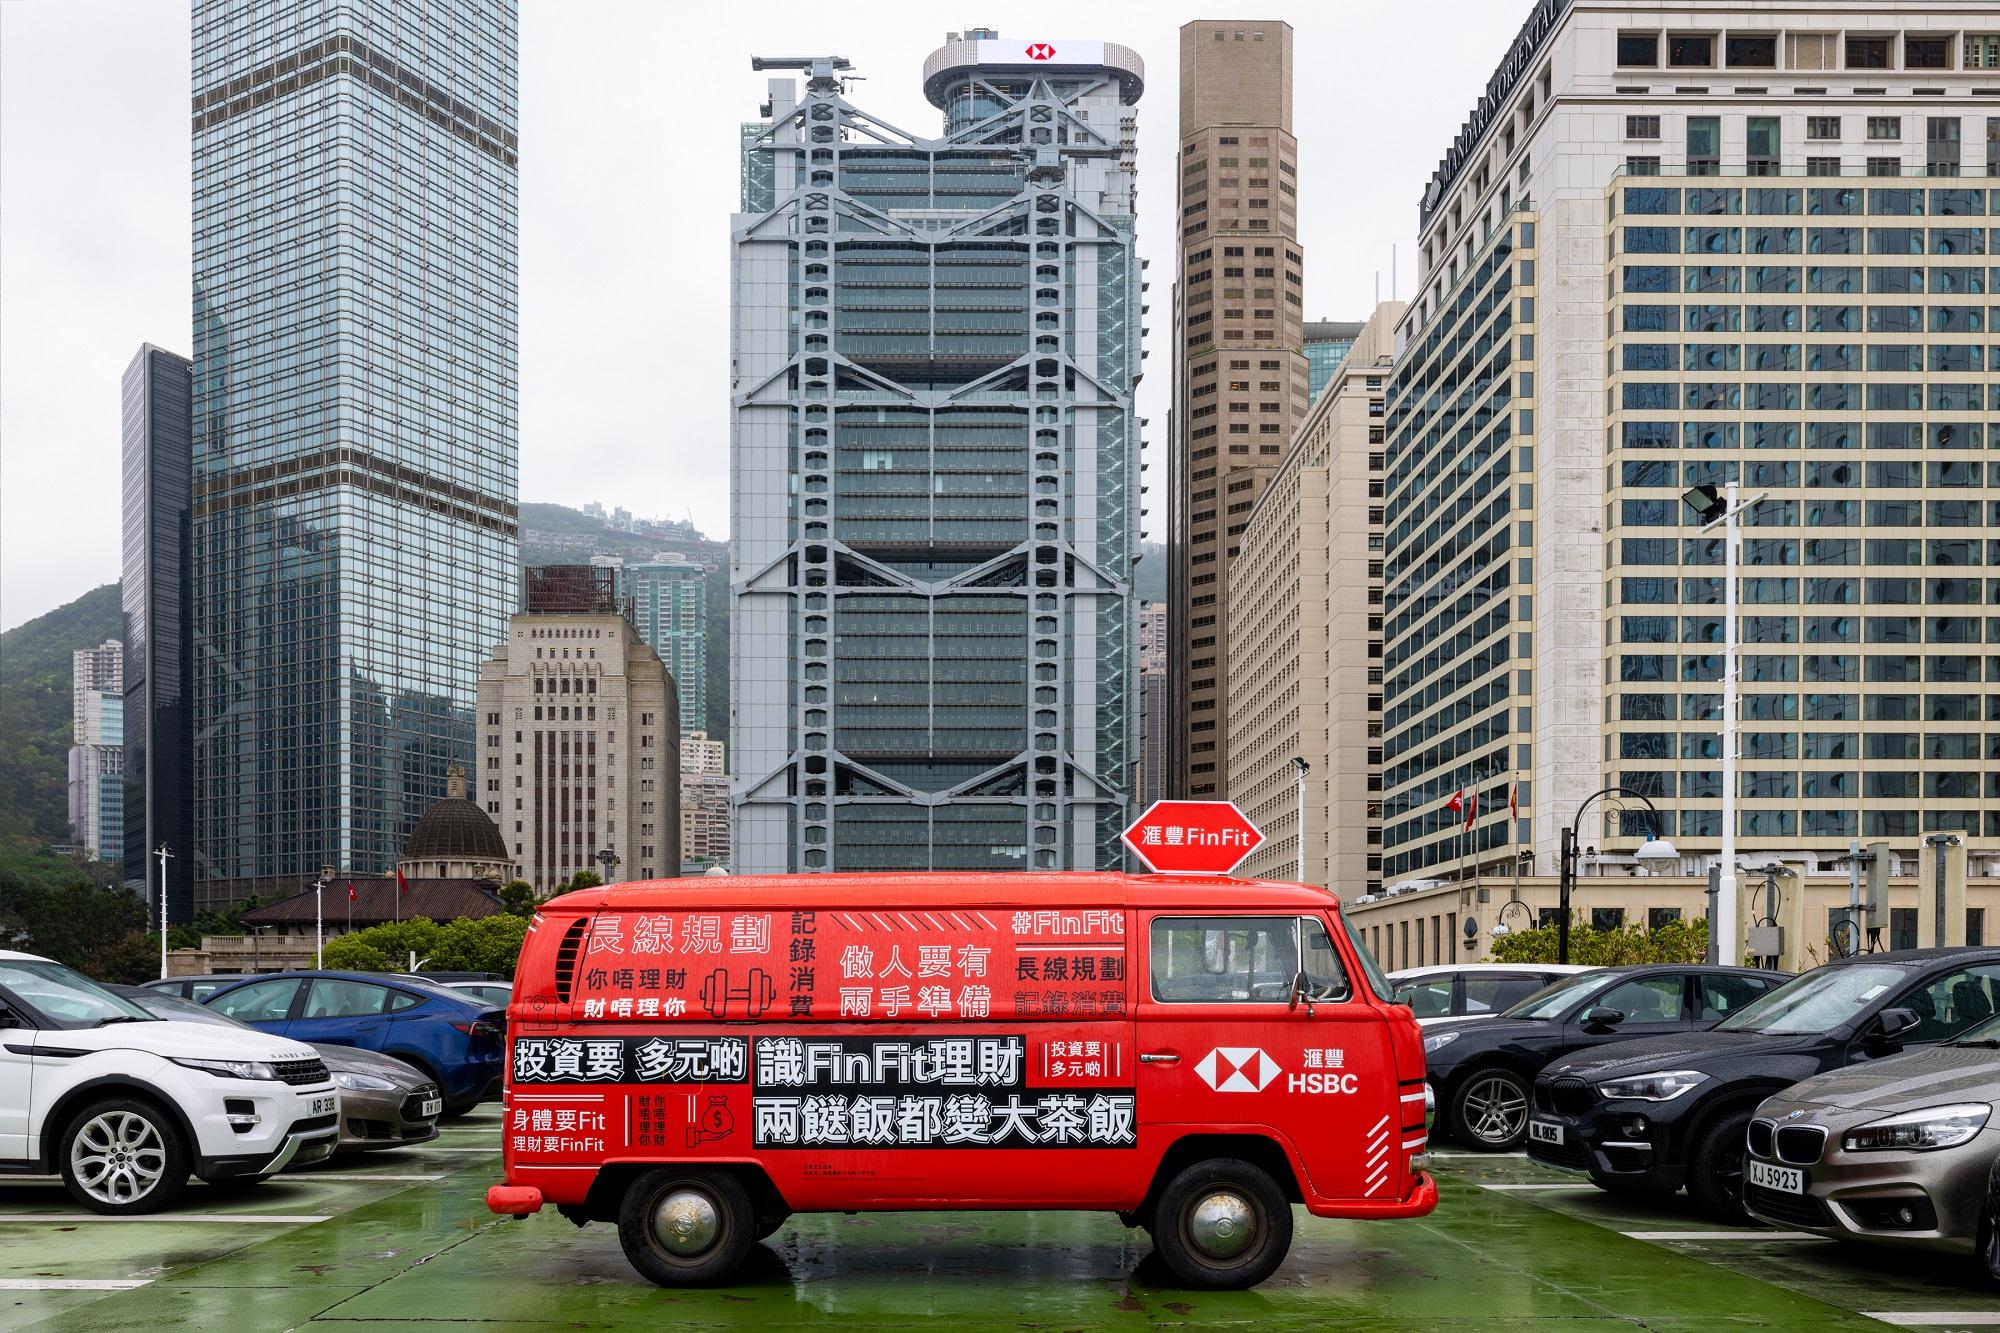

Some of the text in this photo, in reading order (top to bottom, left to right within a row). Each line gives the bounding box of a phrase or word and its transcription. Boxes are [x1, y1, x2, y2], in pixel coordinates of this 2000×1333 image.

[1442, 2, 1559, 189] MANDARIN ORIENTAL
[585, 914, 772, 955] 長線規劃
[1011, 911, 1125, 935] #FinFit
[789, 911, 817, 1018] 記錄消費
[839, 944, 991, 978] 做人要有
[1014, 955, 1125, 981] 長線規劃
[585, 968, 688, 990] 你唔理財
[583, 997, 687, 1018] 財唔理你
[839, 985, 991, 1018] 兩手準備
[1014, 991, 1126, 1017] 記錄消費
[514, 1037, 748, 1082] 投資要 多元啲
[756, 1037, 1024, 1087] 識FinFit理財
[1051, 1041, 1101, 1057] 投資要
[1051, 1061, 1101, 1077] 多元啲
[1288, 1074, 1358, 1094] HSBC
[312, 1100, 322, 1114] AR
[513, 1108, 606, 1131] 身體要Fit
[753, 1094, 1137, 1145] 兩餸飯都變大茶飯
[513, 1136, 605, 1152] 理財要FinFit
[1752, 1163, 1798, 1190] XJ 5923
